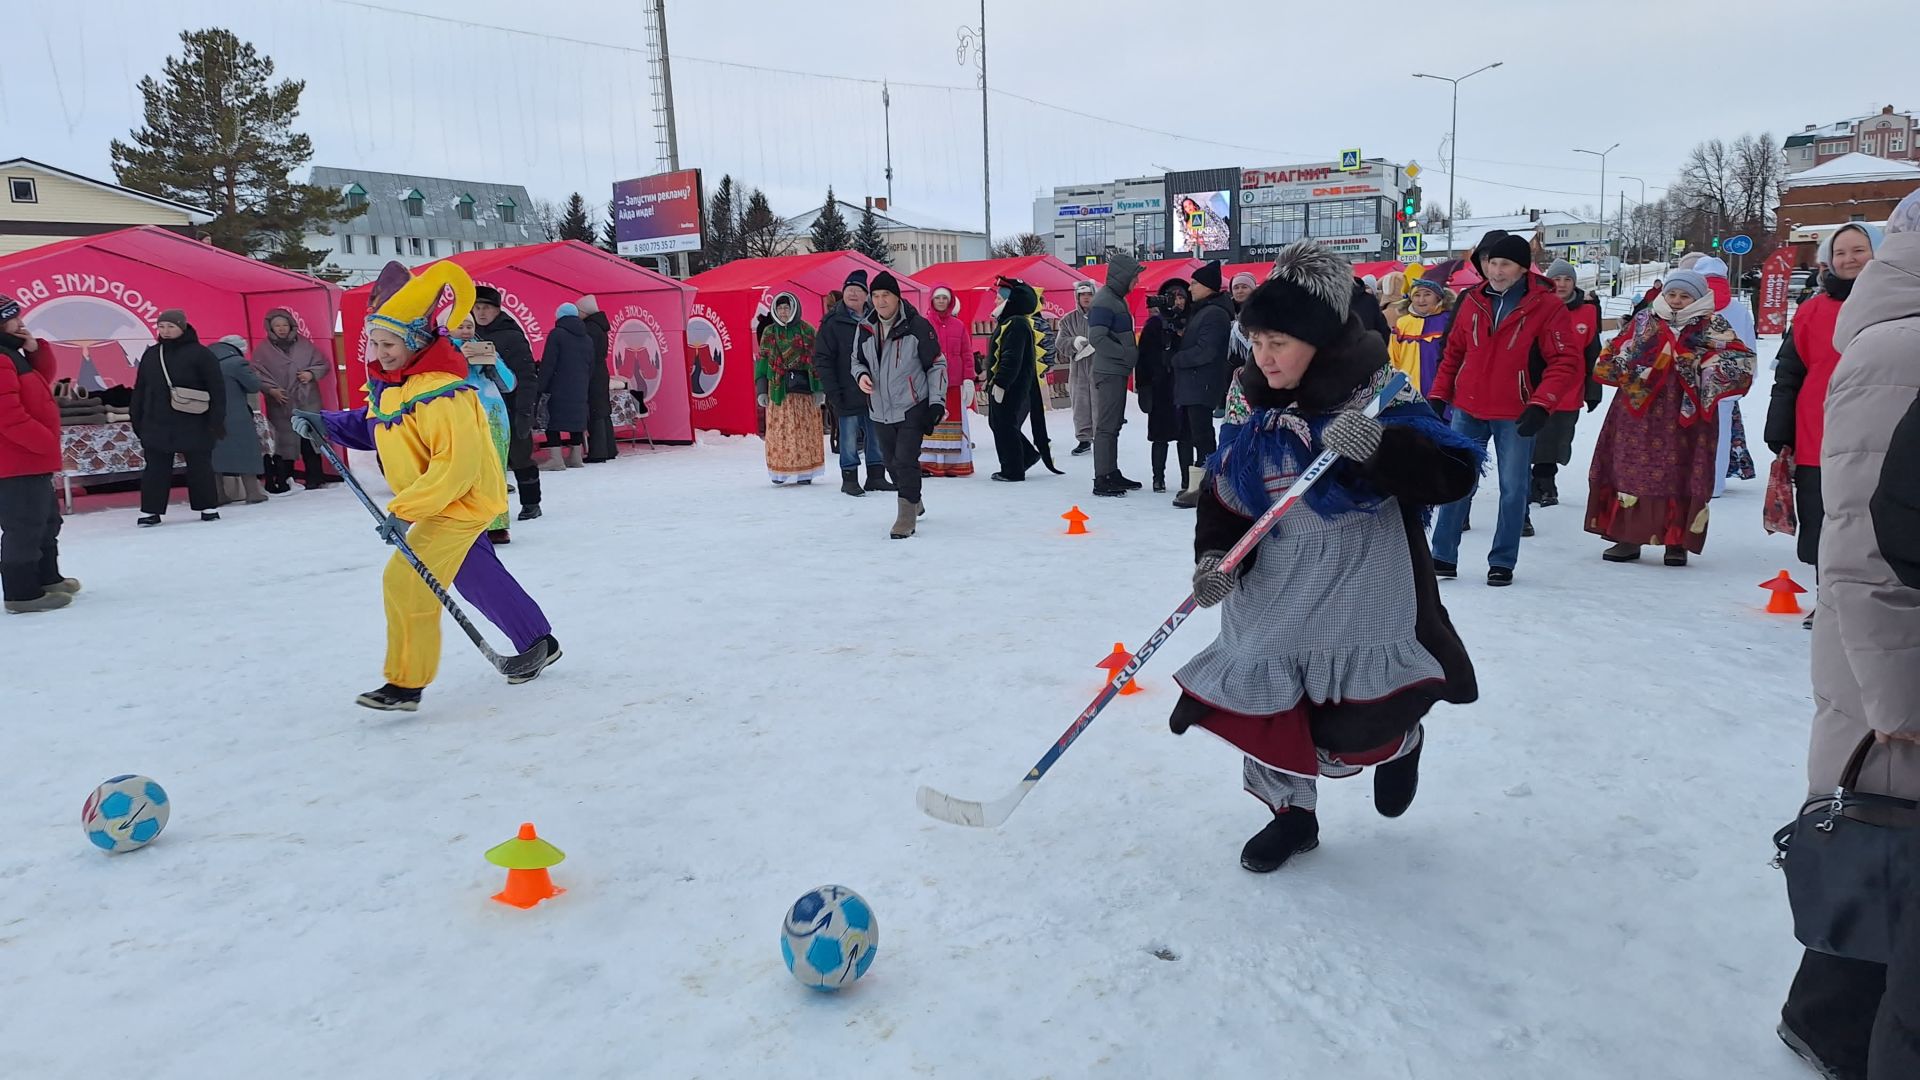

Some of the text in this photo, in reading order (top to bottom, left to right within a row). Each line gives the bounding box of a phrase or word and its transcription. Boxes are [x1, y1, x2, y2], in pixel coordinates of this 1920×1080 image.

[1264, 167, 1331, 184] МАГНИТ
[625, 193, 657, 207] Запустим
[657, 185, 691, 203] рекламу?
[1117, 201, 1145, 211] Кухни
[669, 240, 676, 249] 27
[705, 307, 733, 351] ВАЛЕНКИ
[1112, 611, 1188, 690] RUSSIA
